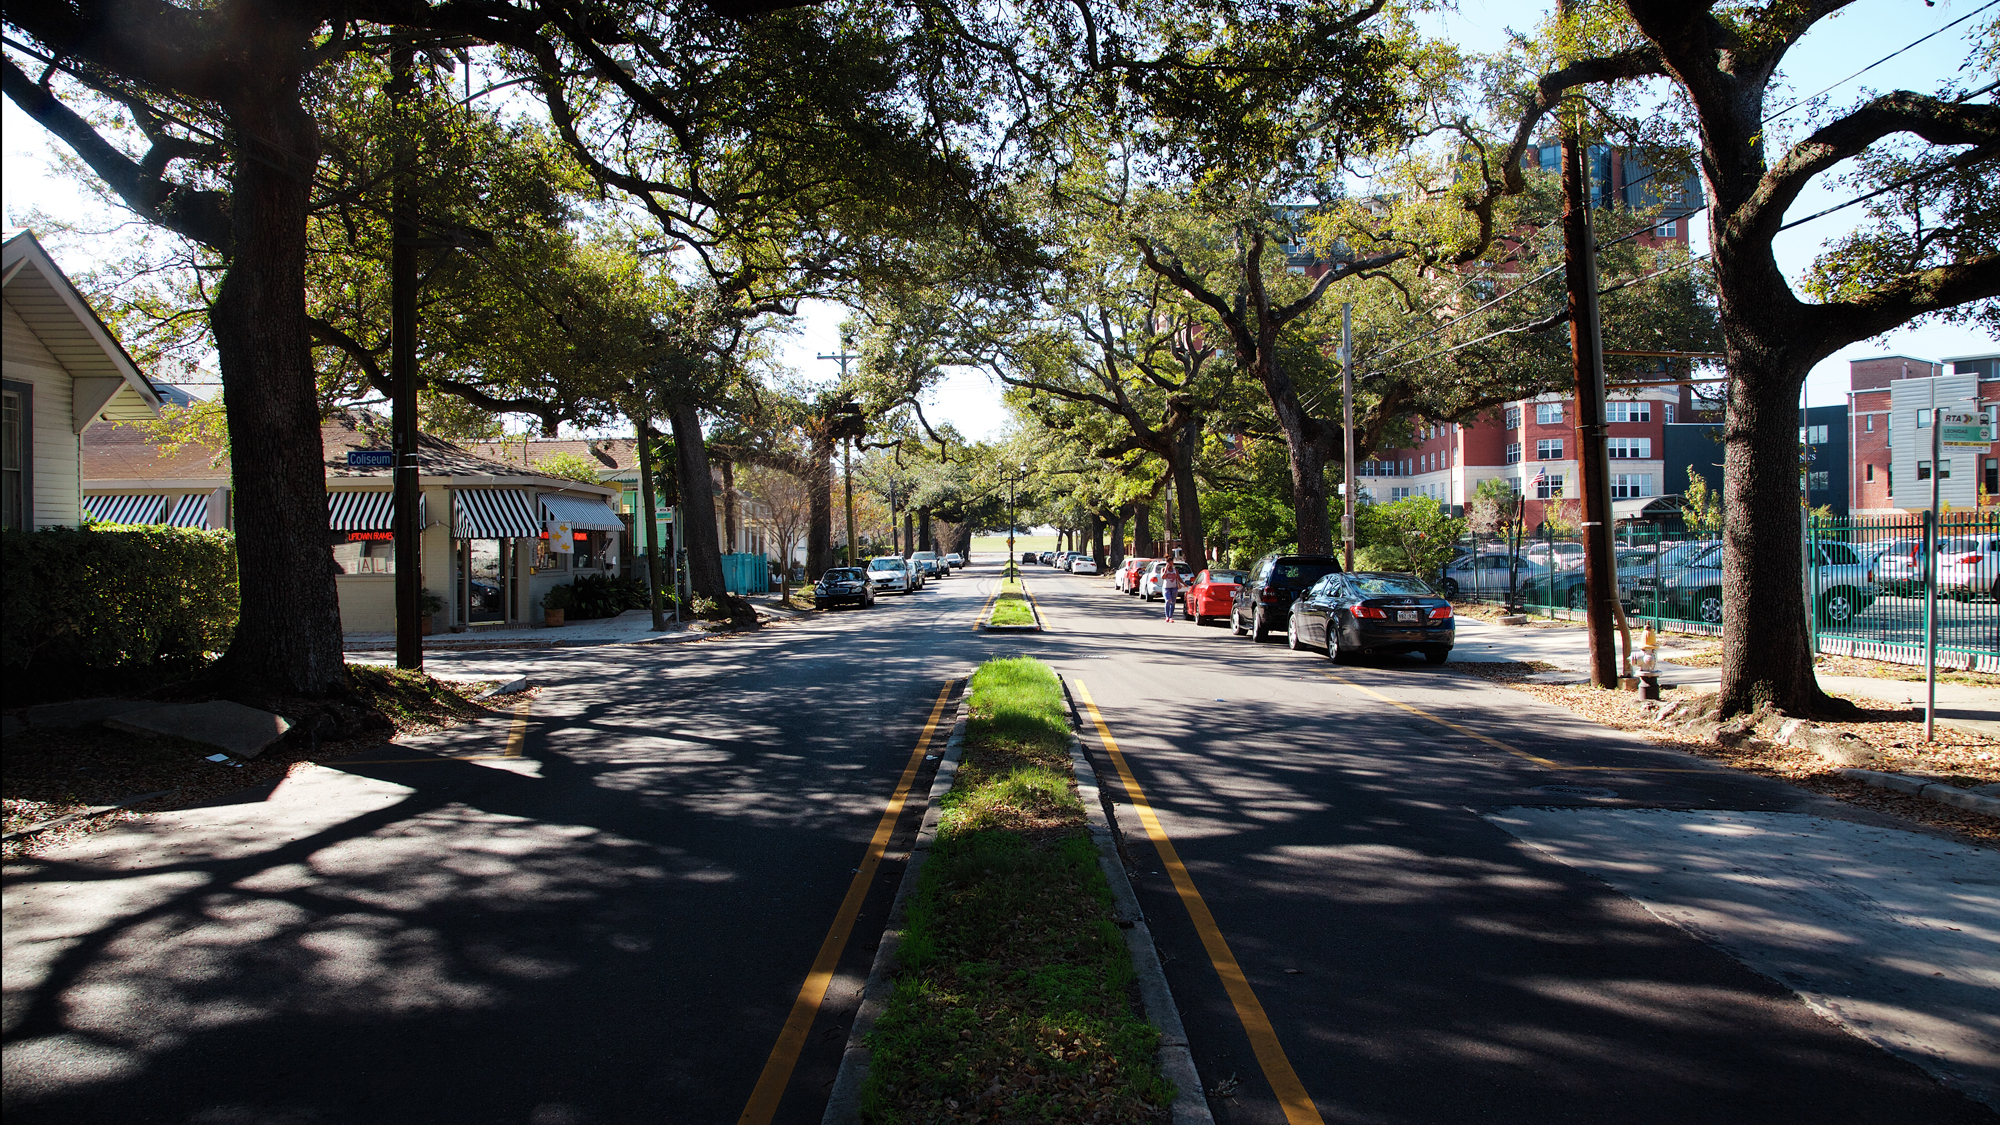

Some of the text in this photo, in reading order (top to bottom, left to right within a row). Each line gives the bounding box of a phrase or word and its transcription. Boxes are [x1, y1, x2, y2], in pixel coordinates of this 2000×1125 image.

[350, 453, 390, 465] Coliseum
[348, 532, 393, 541] UPTOWN FRAMES
[350, 558, 393, 572] SALE
